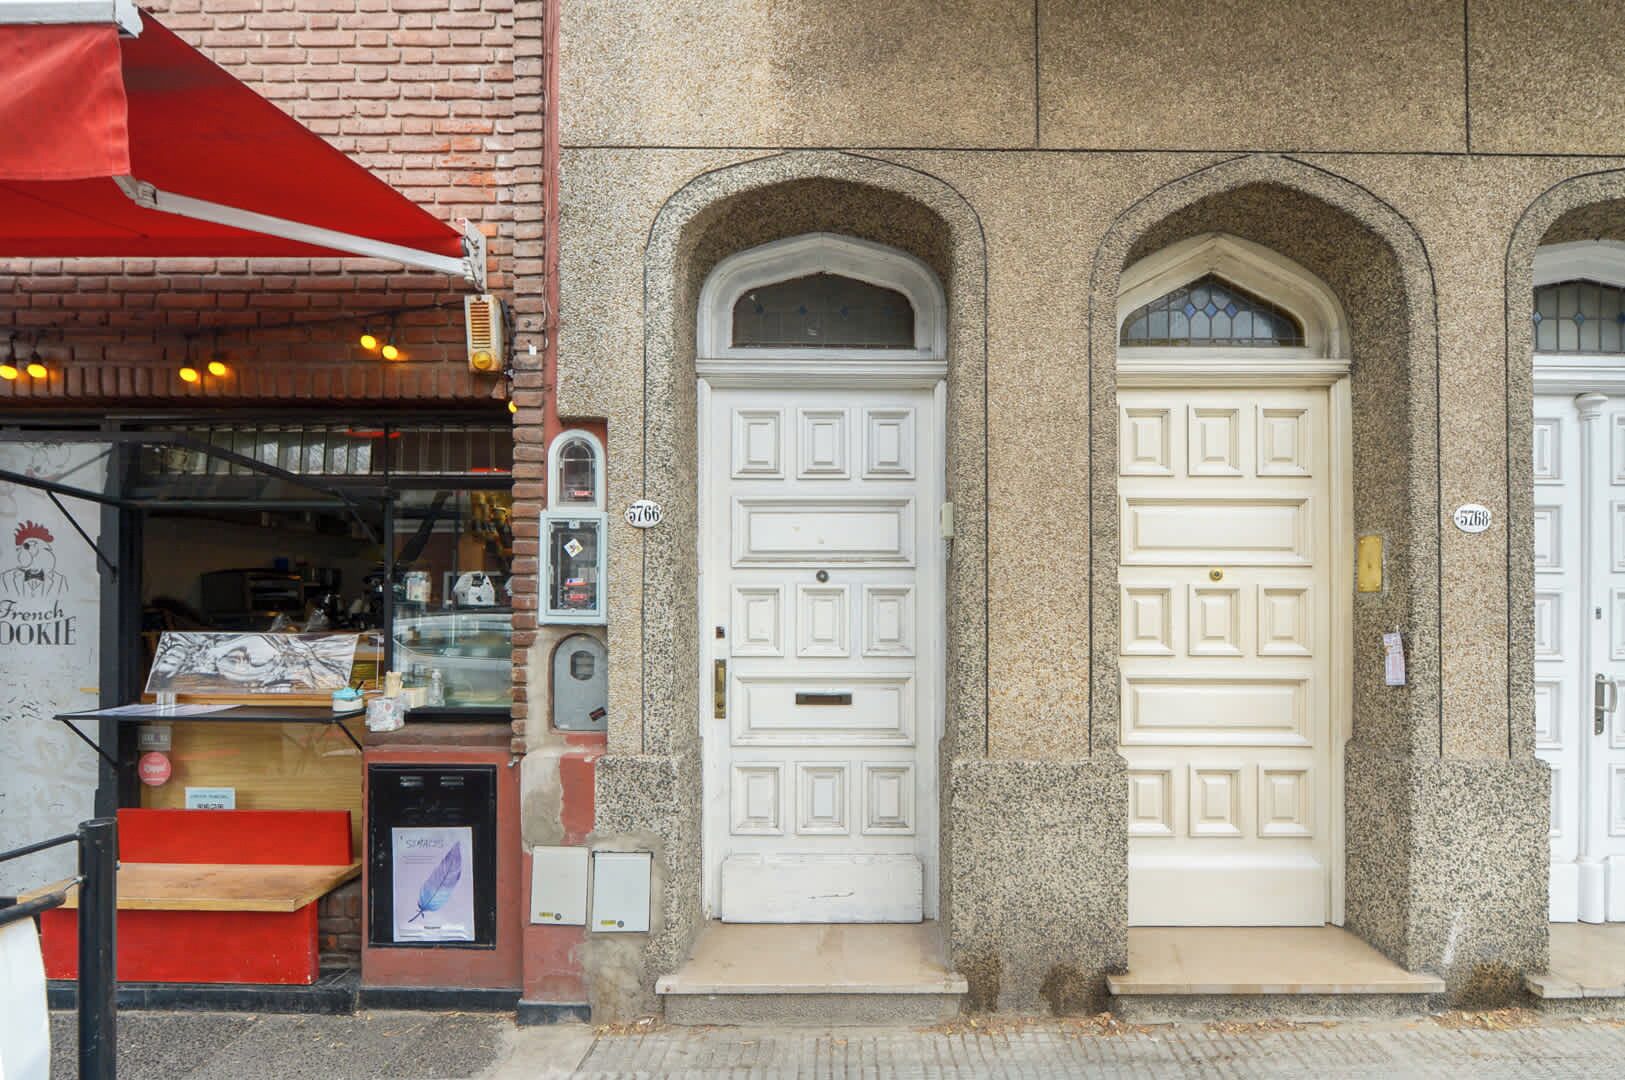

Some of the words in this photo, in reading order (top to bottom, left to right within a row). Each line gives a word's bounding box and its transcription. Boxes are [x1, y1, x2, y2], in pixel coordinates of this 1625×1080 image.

[629, 505, 660, 522] 5766
[1460, 510, 1489, 526] 5768
[0, 599, 64, 620] French
[0, 616, 77, 645] OOKIE
